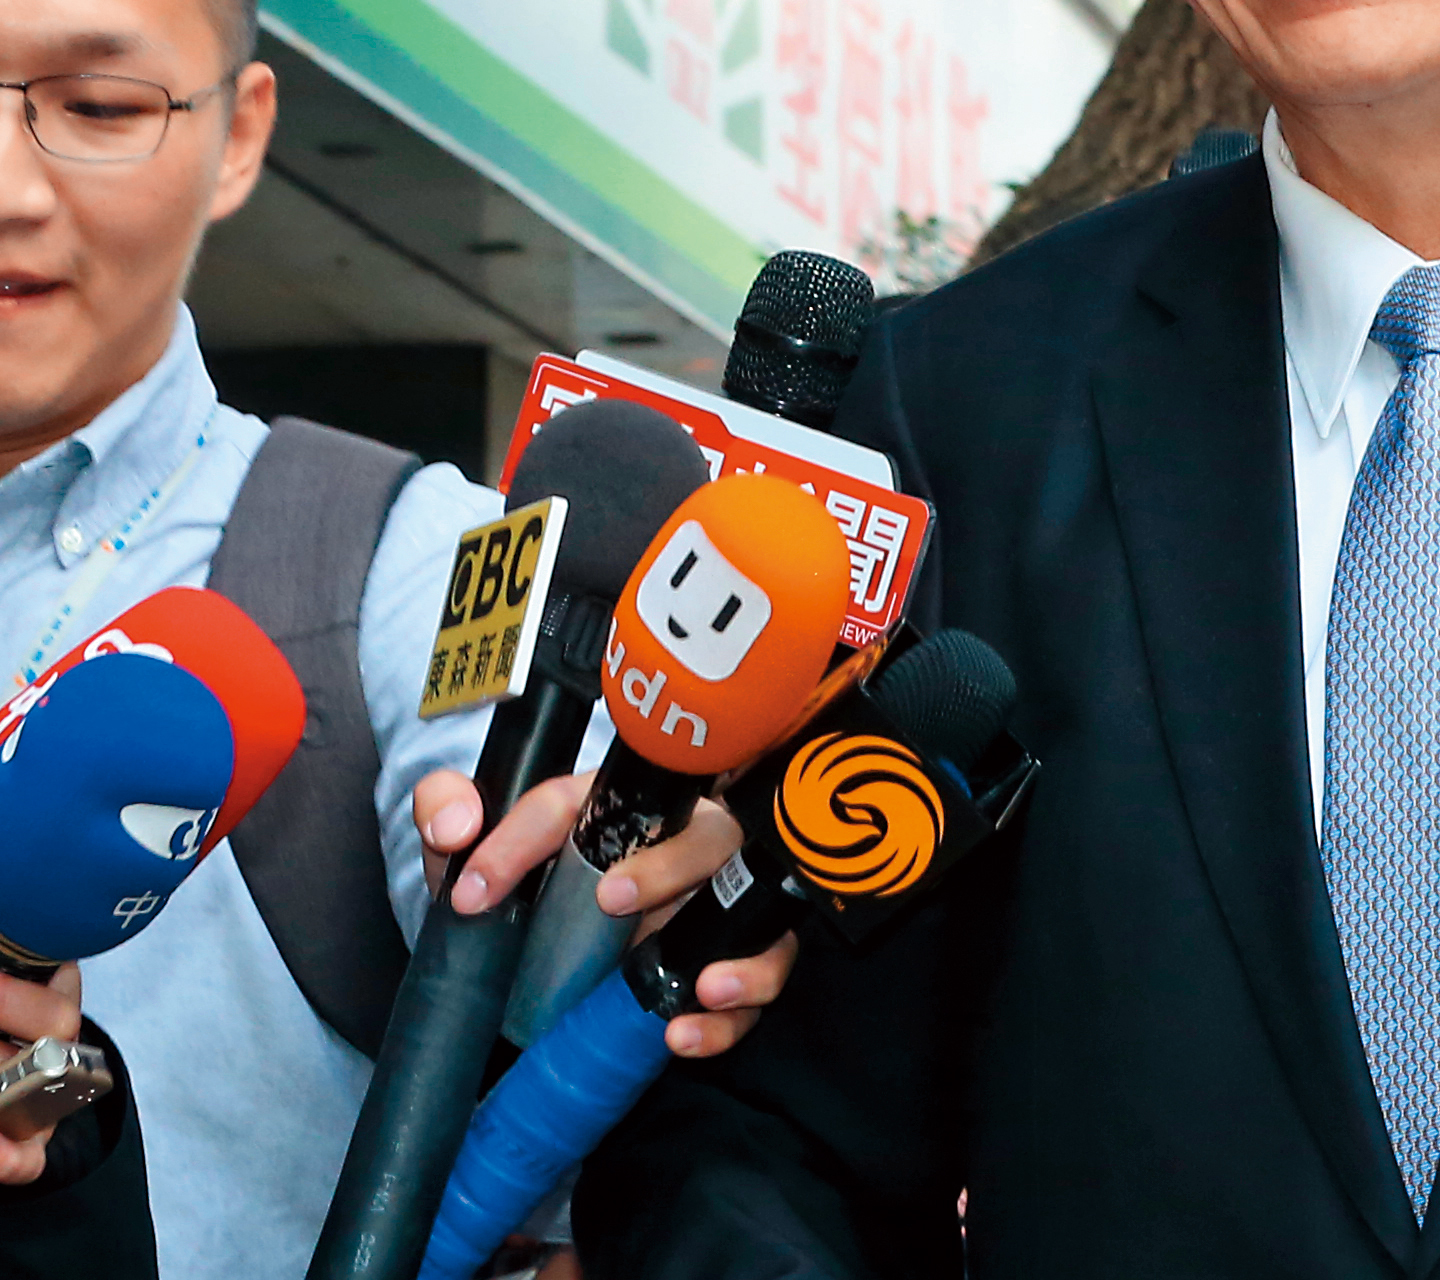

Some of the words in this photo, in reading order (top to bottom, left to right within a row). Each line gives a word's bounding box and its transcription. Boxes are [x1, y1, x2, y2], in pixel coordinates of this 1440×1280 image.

[423, 623, 521, 703] 東森新聞
[606, 616, 708, 747] udn
